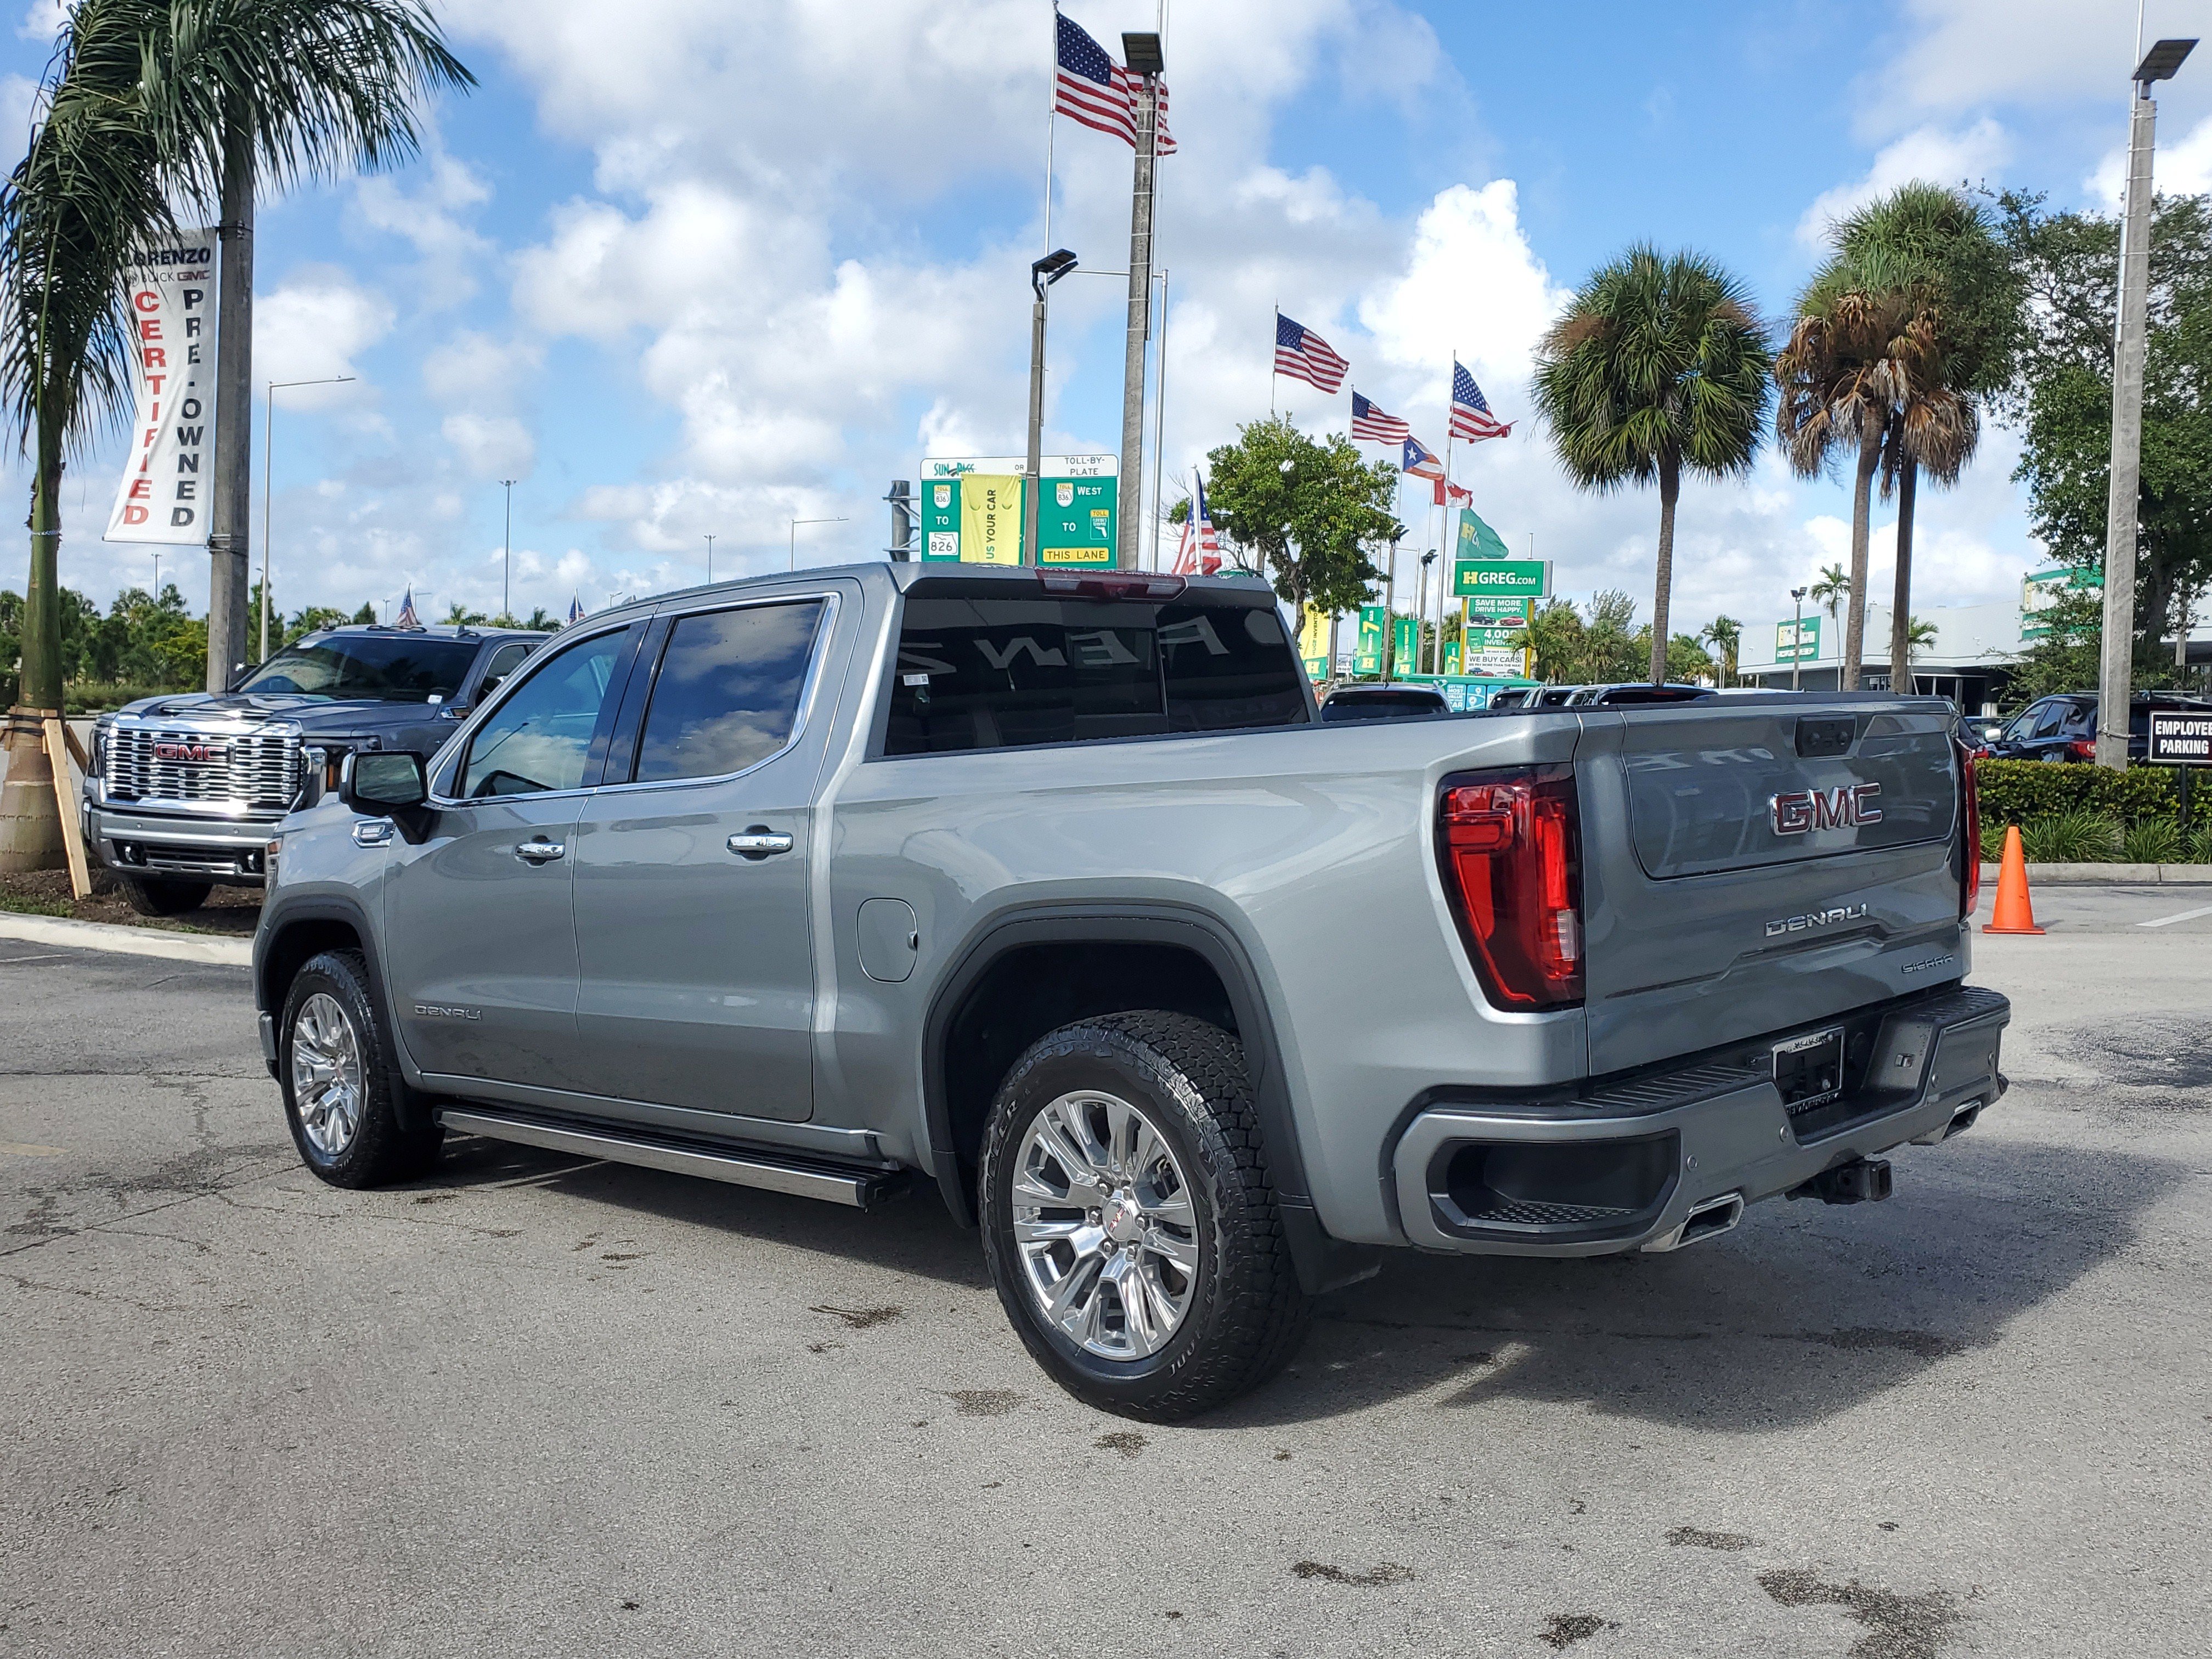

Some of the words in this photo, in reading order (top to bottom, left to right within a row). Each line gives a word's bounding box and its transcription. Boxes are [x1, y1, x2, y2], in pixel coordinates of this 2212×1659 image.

[177, 270, 210, 281] GMC
[123, 291, 166, 526] CERTIFIED
[1077, 486, 1102, 495] WEST
[987, 489, 996, 511] CAR
[935, 516, 949, 525] TO
[1062, 522, 1076, 532] TO
[986, 514, 996, 543] YOUR
[930, 541, 953, 551] 826
[986, 546, 995, 559] US
[1047, 551, 1070, 560] THIS
[1077, 550, 1105, 559] LANE
[1362, 620, 1380, 633] 7
[2155, 720, 2212, 736] EMPLOYEE
[155, 742, 229, 761] GMC
[2160, 739, 2209, 754] PARKING
[1769, 781, 1883, 837] GMC
[1764, 902, 1867, 937] DENALI
[1901, 953, 1955, 974] SIERRA
[414, 1005, 483, 1021] DENALI
